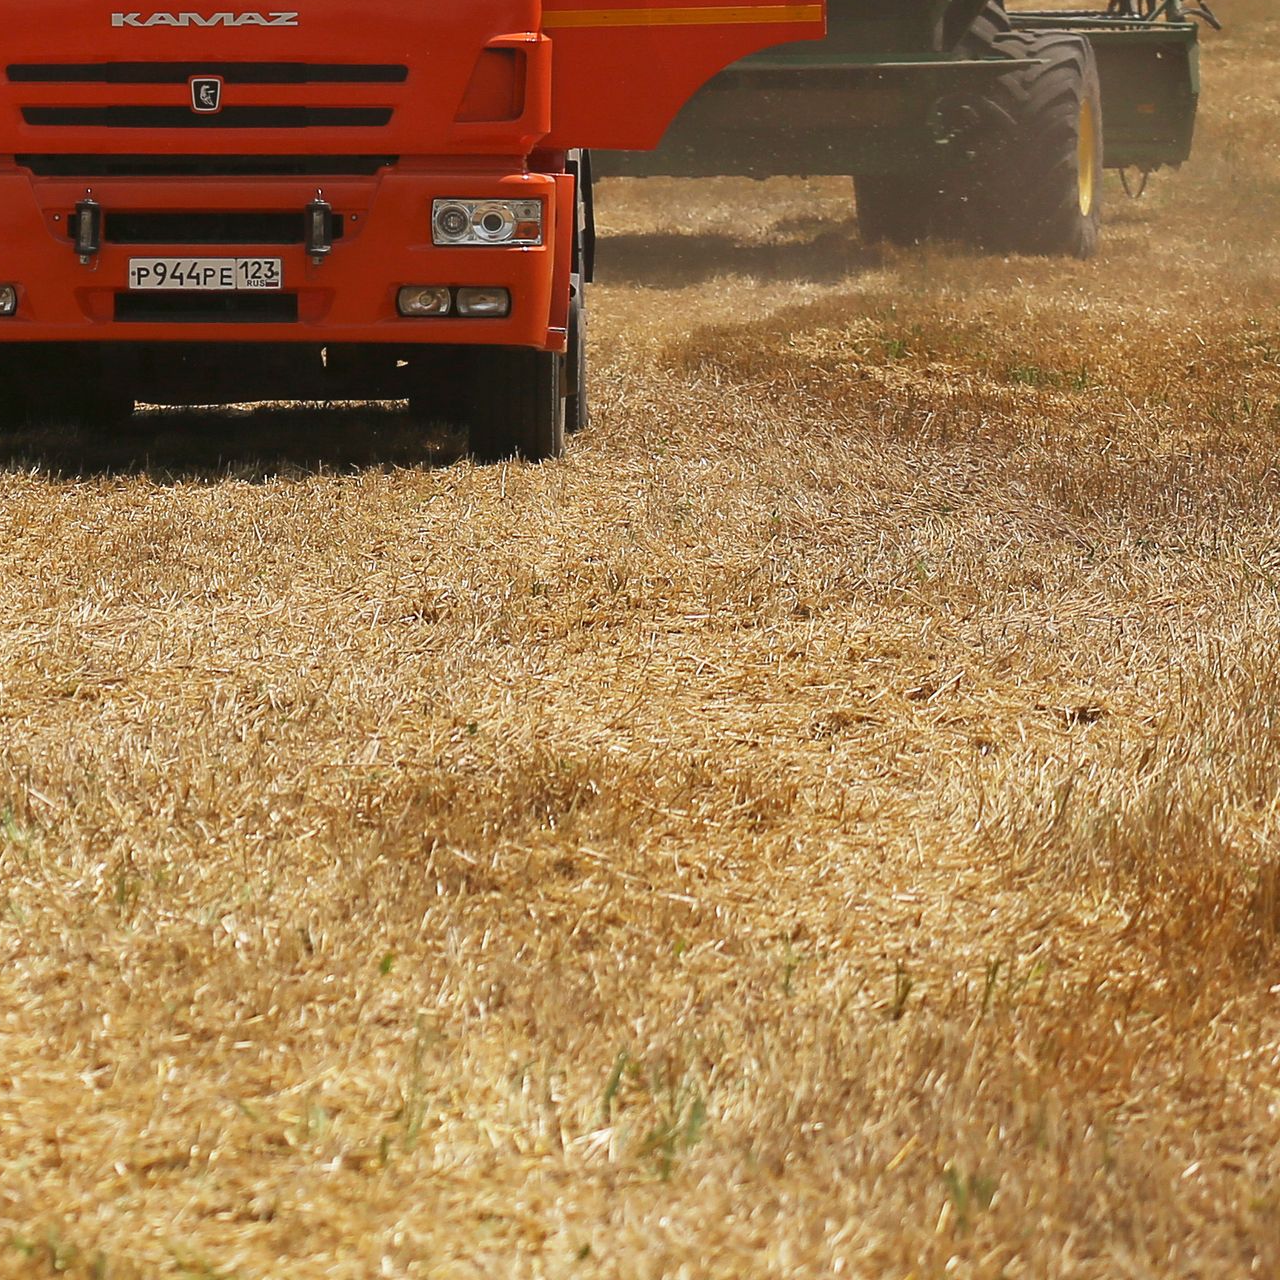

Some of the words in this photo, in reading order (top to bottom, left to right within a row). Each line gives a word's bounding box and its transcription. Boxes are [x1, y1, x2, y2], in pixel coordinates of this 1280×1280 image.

[111, 12, 299, 27] KAMAZ
[136, 261, 233, 286] Р944РЕ
[238, 261, 275, 279] 123
[246, 279, 265, 287] RUS
